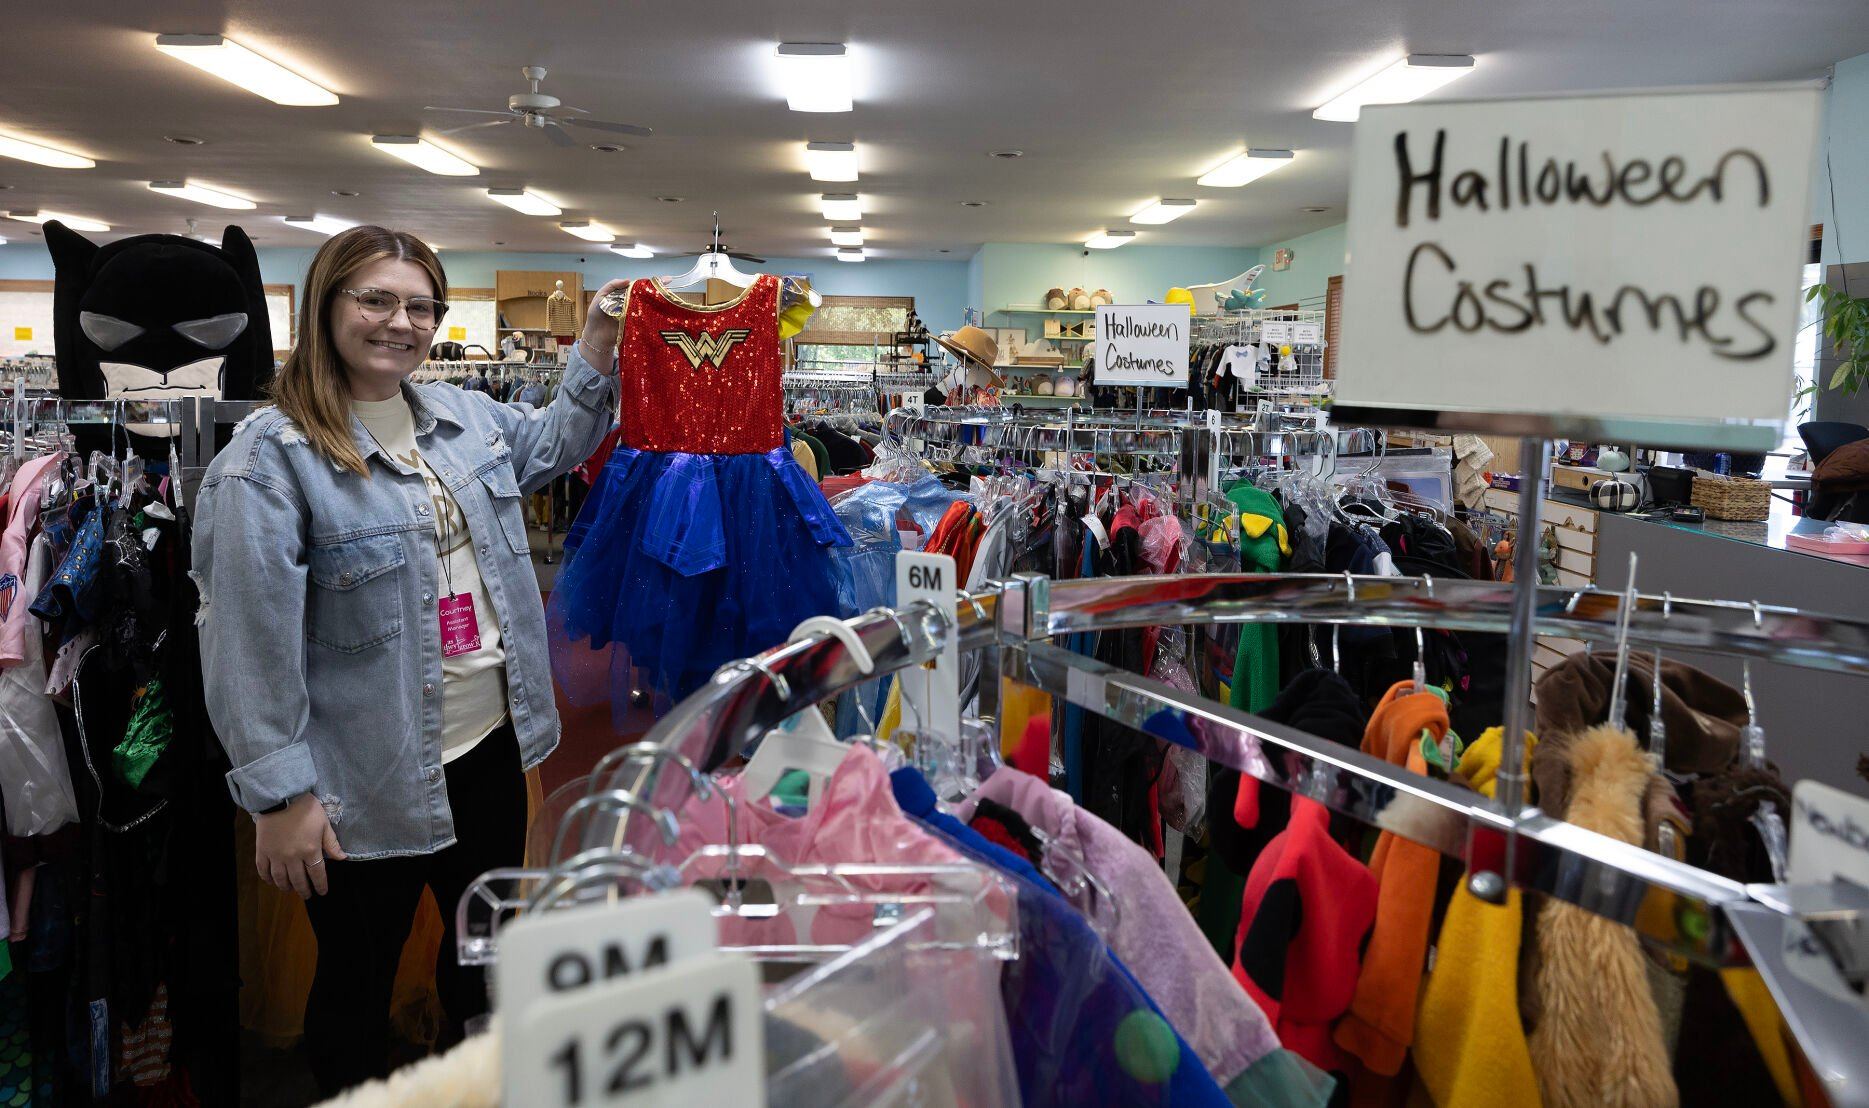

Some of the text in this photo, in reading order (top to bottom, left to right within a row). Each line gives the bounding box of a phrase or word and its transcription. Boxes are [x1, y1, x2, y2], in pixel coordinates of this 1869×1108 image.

[1394, 128, 1771, 228] Halloween
[1403, 242, 1778, 361] Costumes
[1105, 312, 1179, 341] Halloween
[1105, 342, 1175, 376] Costumes
[907, 395, 919, 404] 4T
[1211, 414, 1216, 425] 6
[908, 564, 942, 592] 6M
[440, 606, 472, 617] Courtney
[446, 616, 469, 626] Assistant
[447, 623, 470, 632] Manager
[550, 990, 735, 1108] 12M
